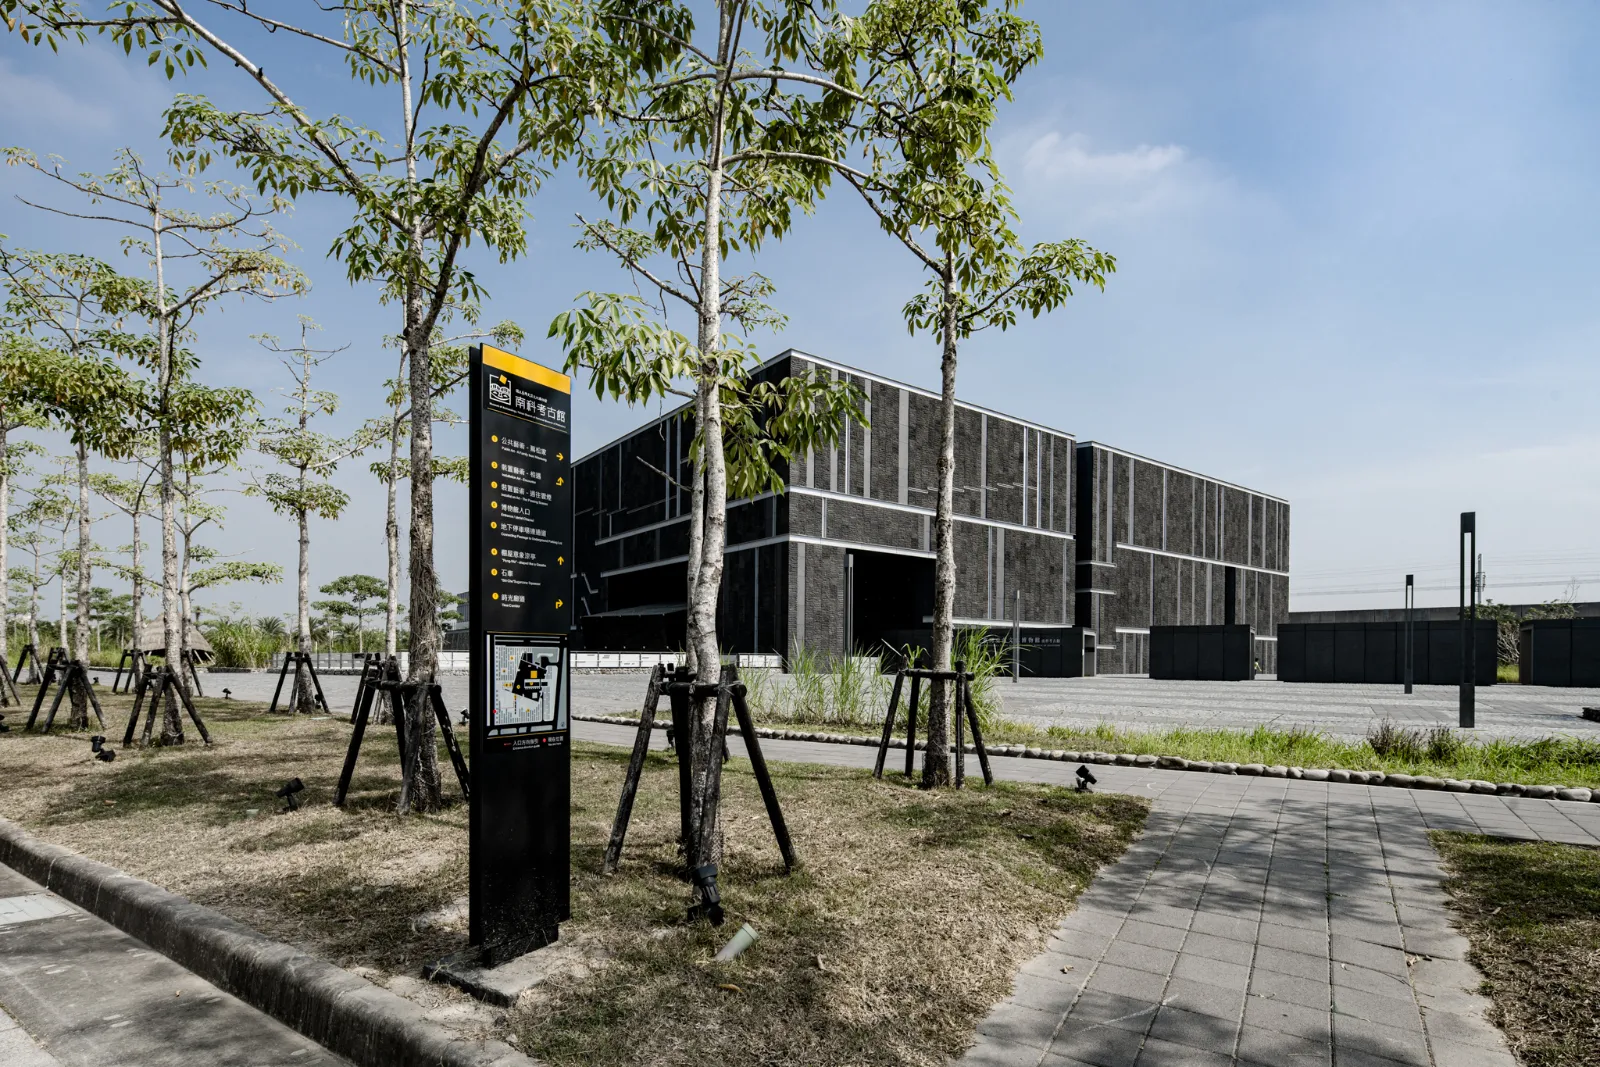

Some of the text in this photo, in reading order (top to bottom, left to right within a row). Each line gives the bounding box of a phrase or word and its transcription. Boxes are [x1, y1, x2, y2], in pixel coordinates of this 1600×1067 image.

[515, 396, 566, 423] 南科考古館
